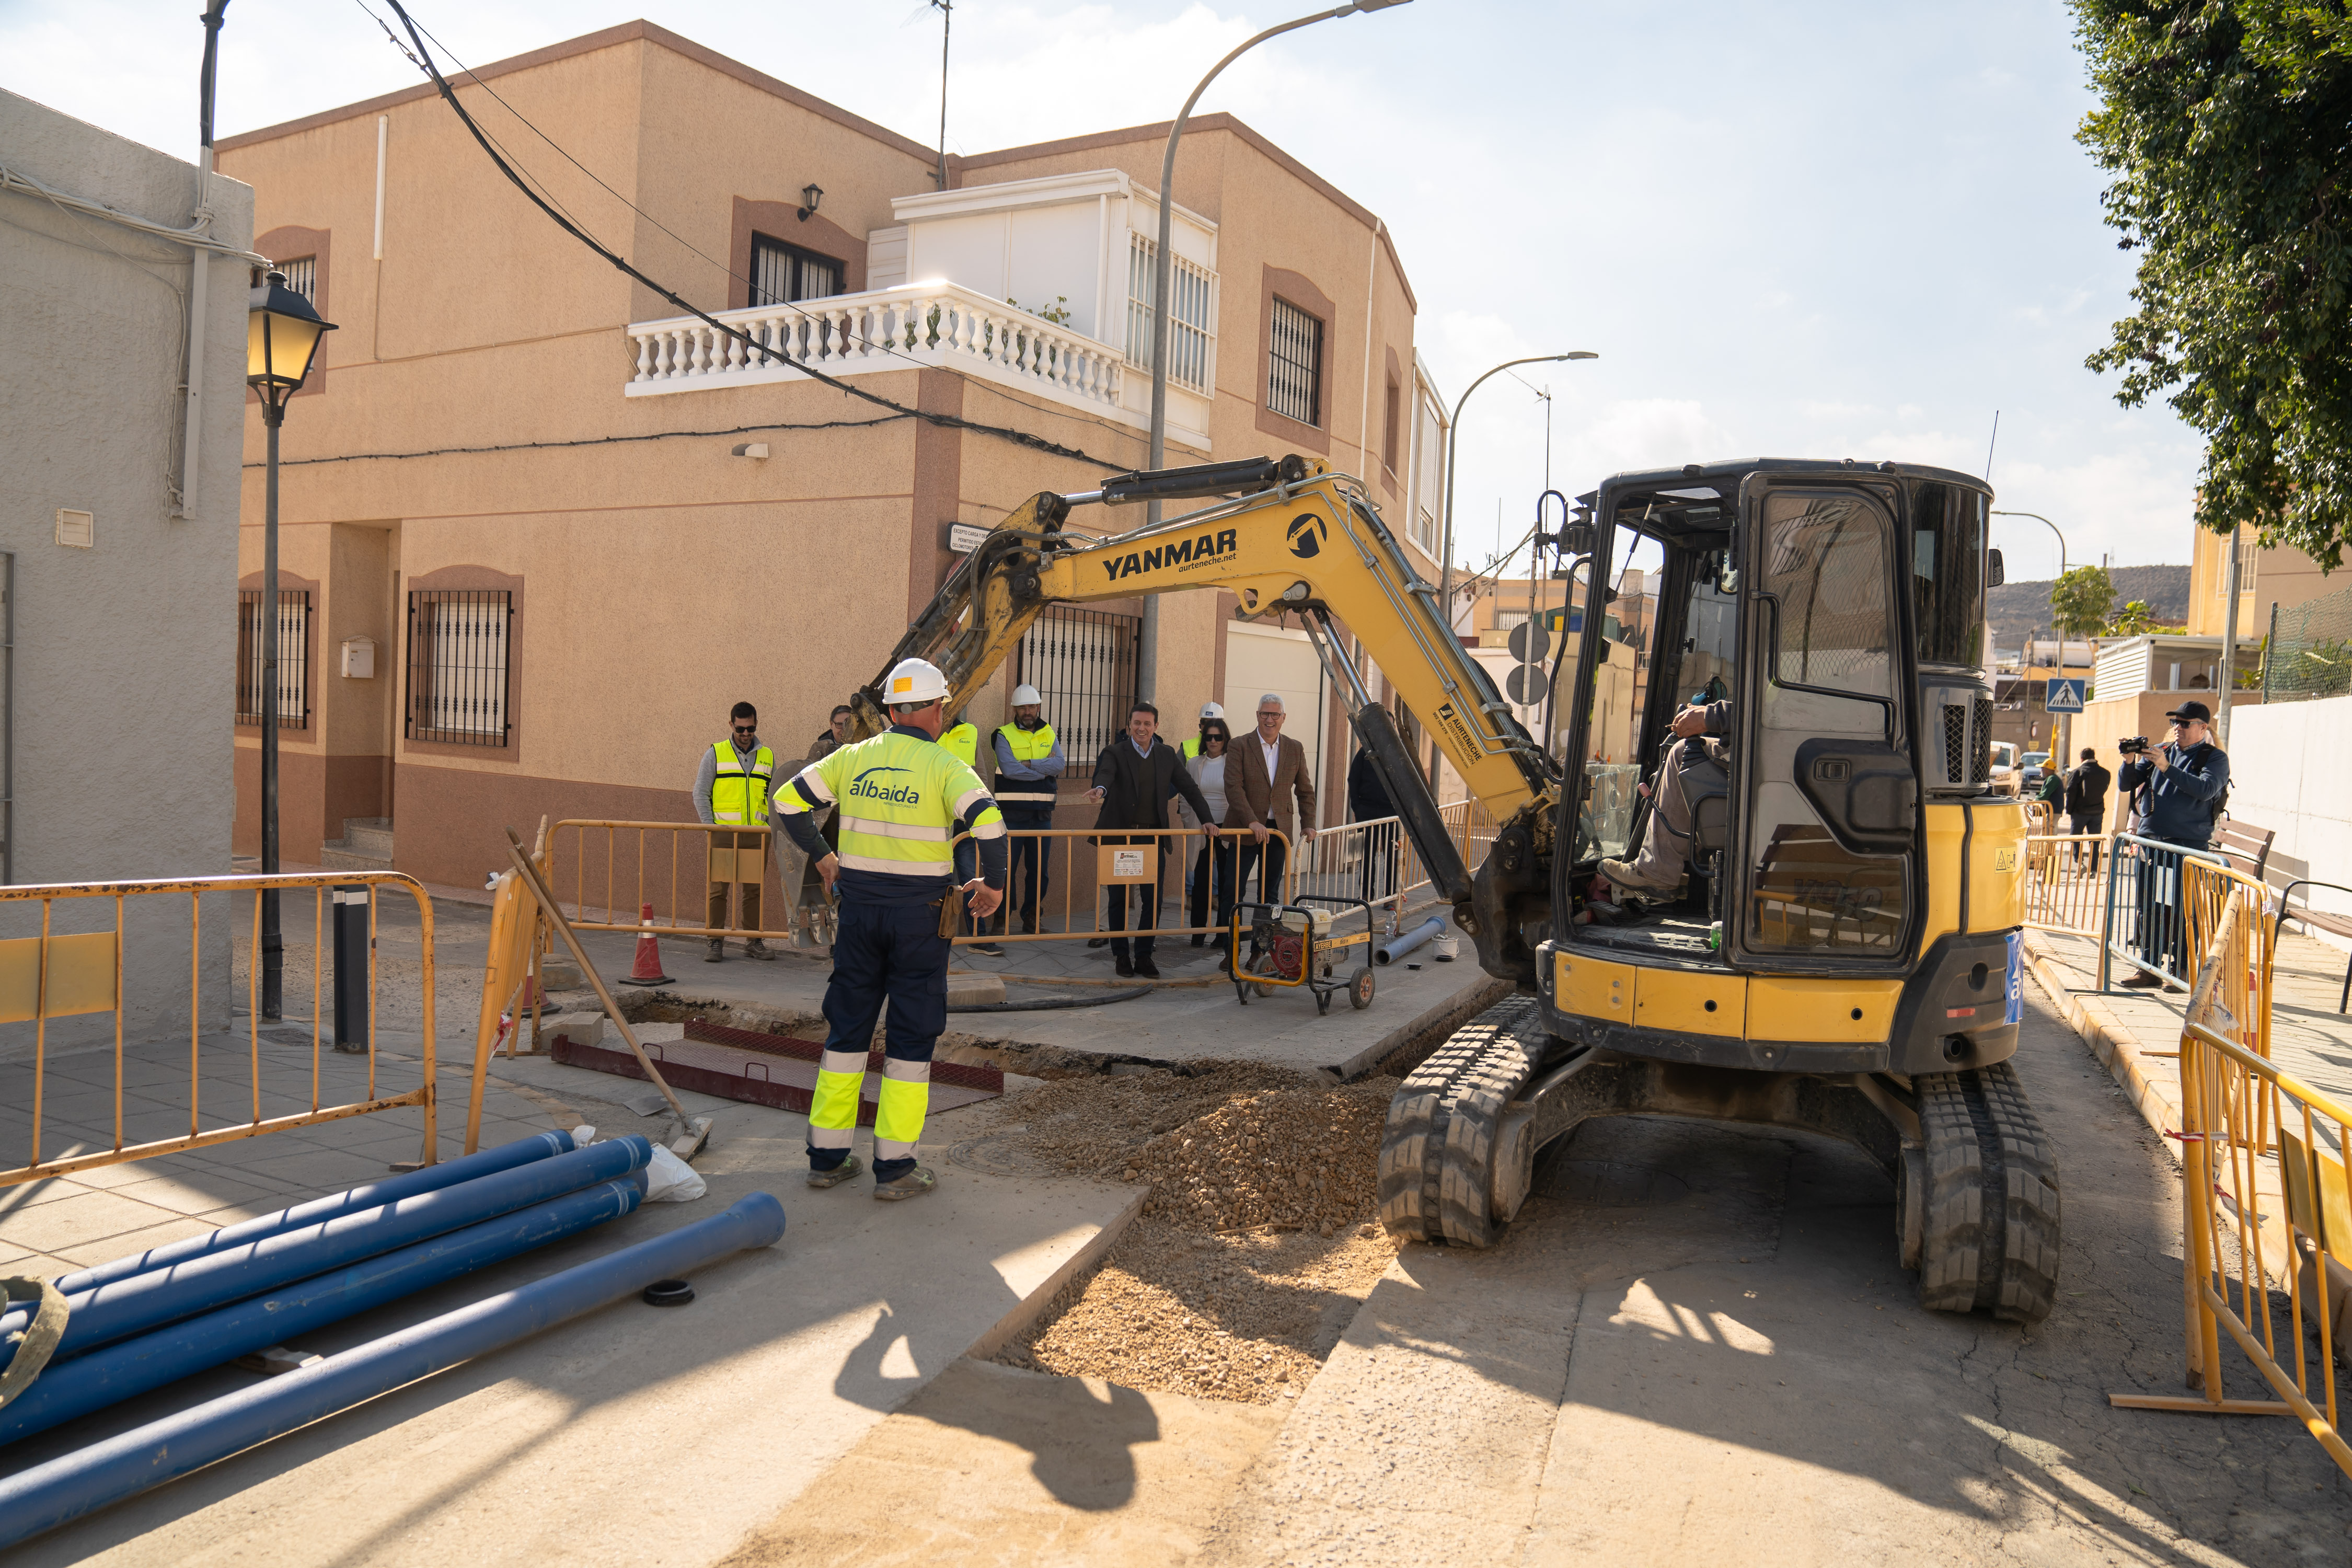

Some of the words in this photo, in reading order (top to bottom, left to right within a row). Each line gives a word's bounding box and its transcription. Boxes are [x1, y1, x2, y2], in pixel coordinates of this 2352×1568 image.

[1102, 528, 1236, 581] YANMAR
[1179, 552, 1237, 573] aurteneche.net
[1447, 722, 1475, 765] DISTRIBUCIÓN
[1452, 719, 1482, 761] AURTENECHE
[849, 780, 919, 804] albaida
[1315, 941, 1331, 950] AYERBE
